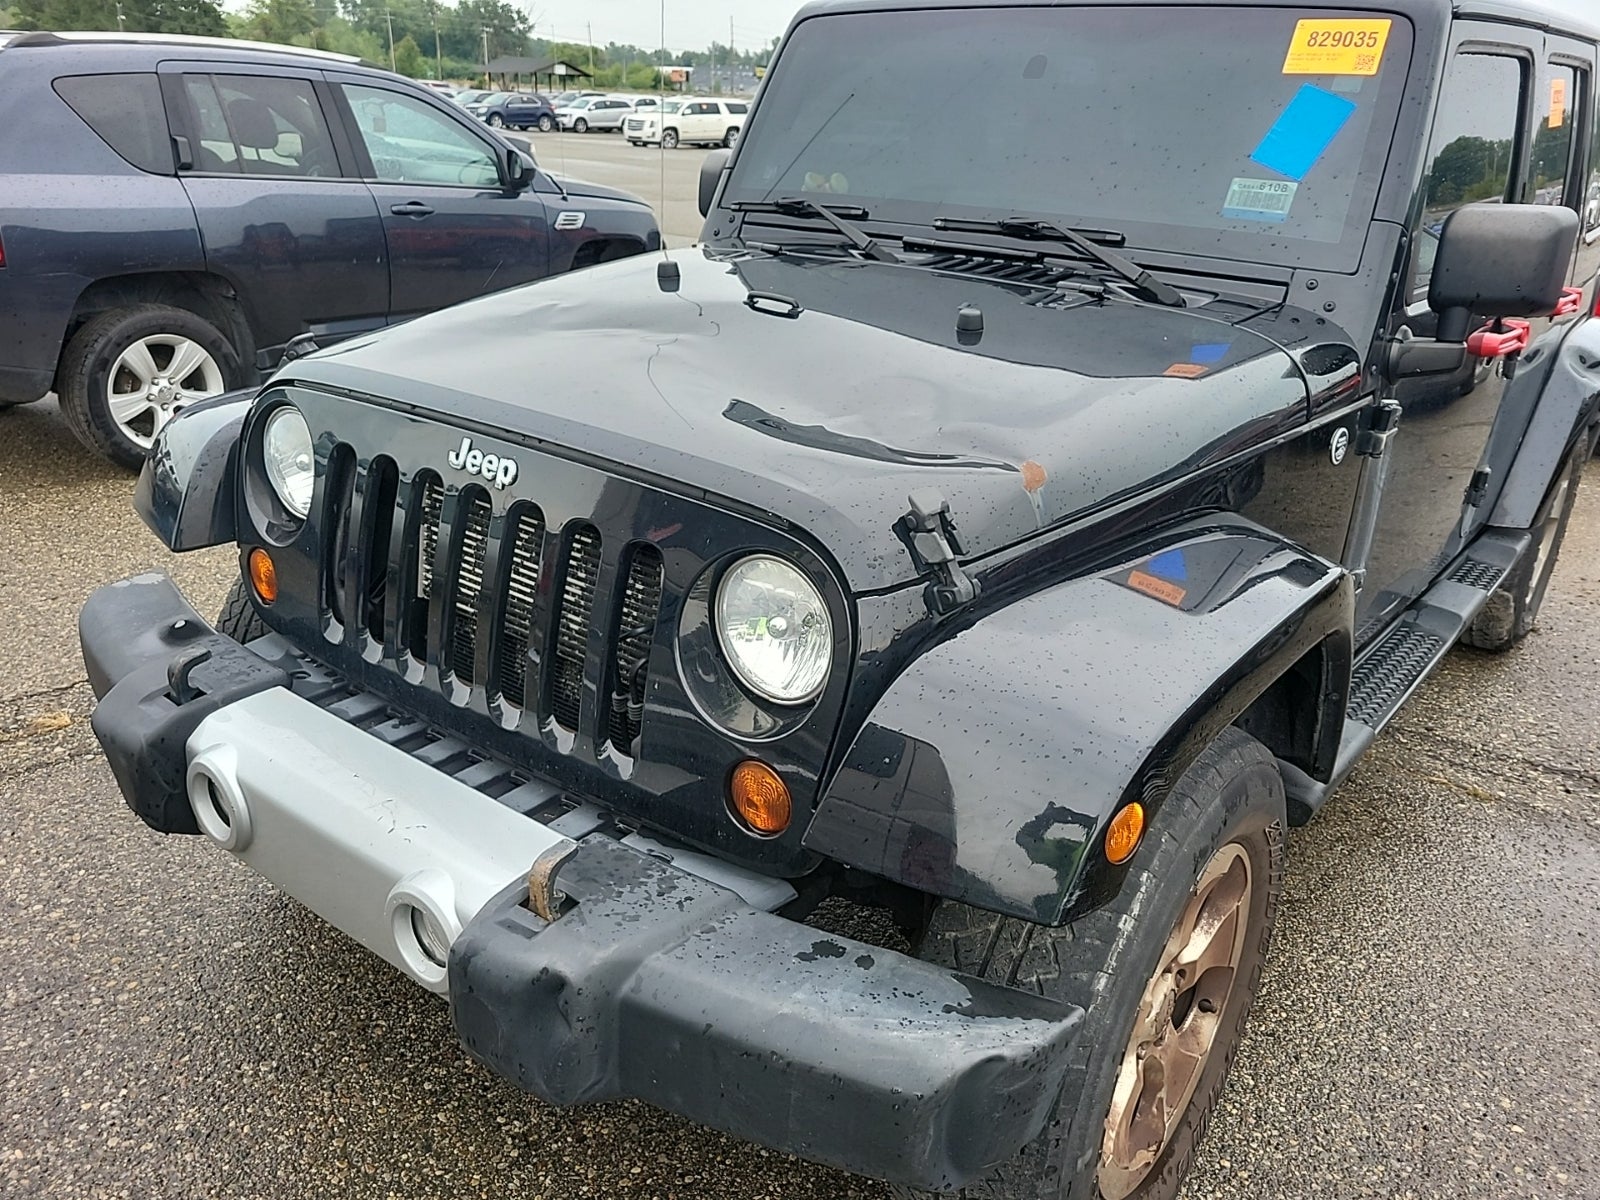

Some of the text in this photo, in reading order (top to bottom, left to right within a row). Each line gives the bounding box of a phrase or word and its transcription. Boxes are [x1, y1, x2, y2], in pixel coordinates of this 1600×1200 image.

[1307, 31, 1379, 48] 829035
[1259, 182, 1288, 193] 6108
[448, 437, 518, 490] Jeep
